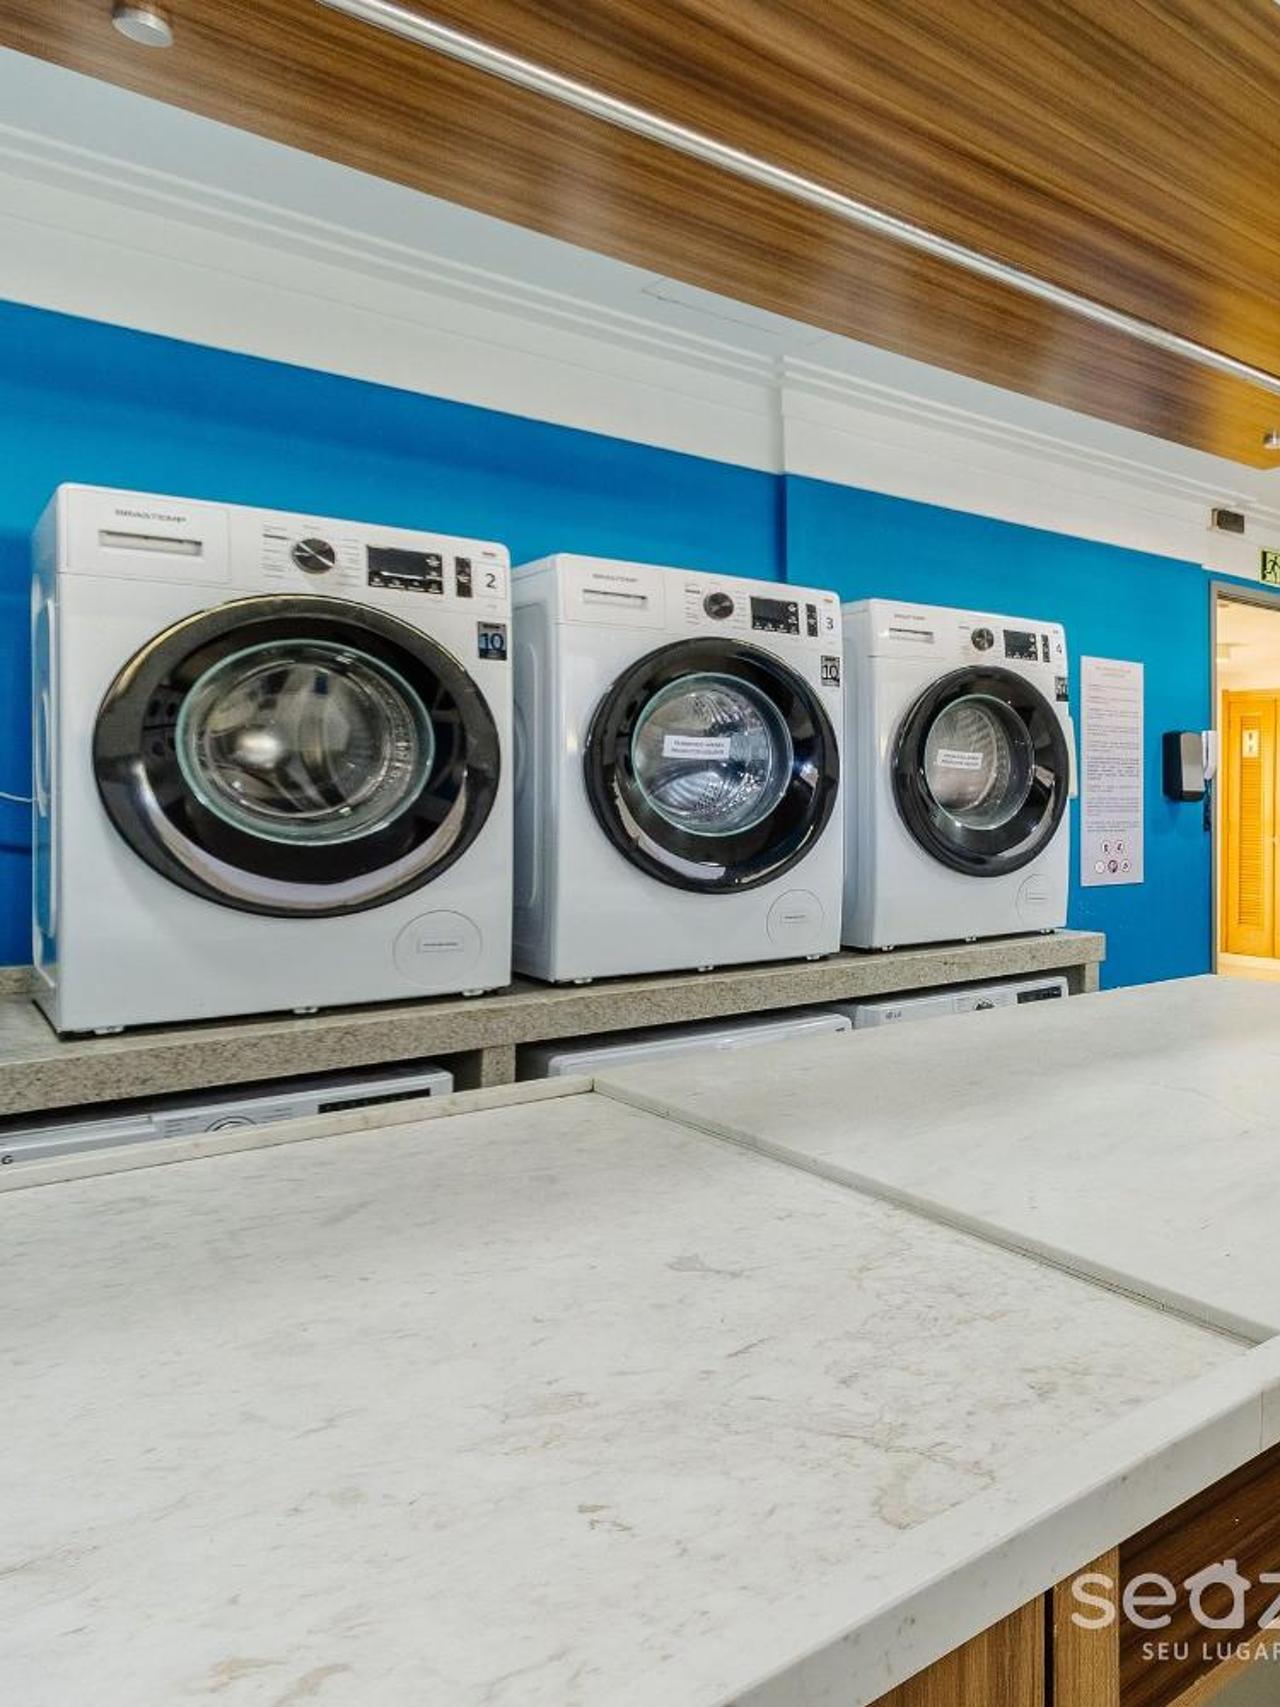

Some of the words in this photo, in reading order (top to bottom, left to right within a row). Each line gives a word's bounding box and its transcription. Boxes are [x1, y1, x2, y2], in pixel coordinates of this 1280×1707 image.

[485, 573, 496, 590] 2
[826, 617, 834, 630] 3
[480, 632, 504, 651] 10
